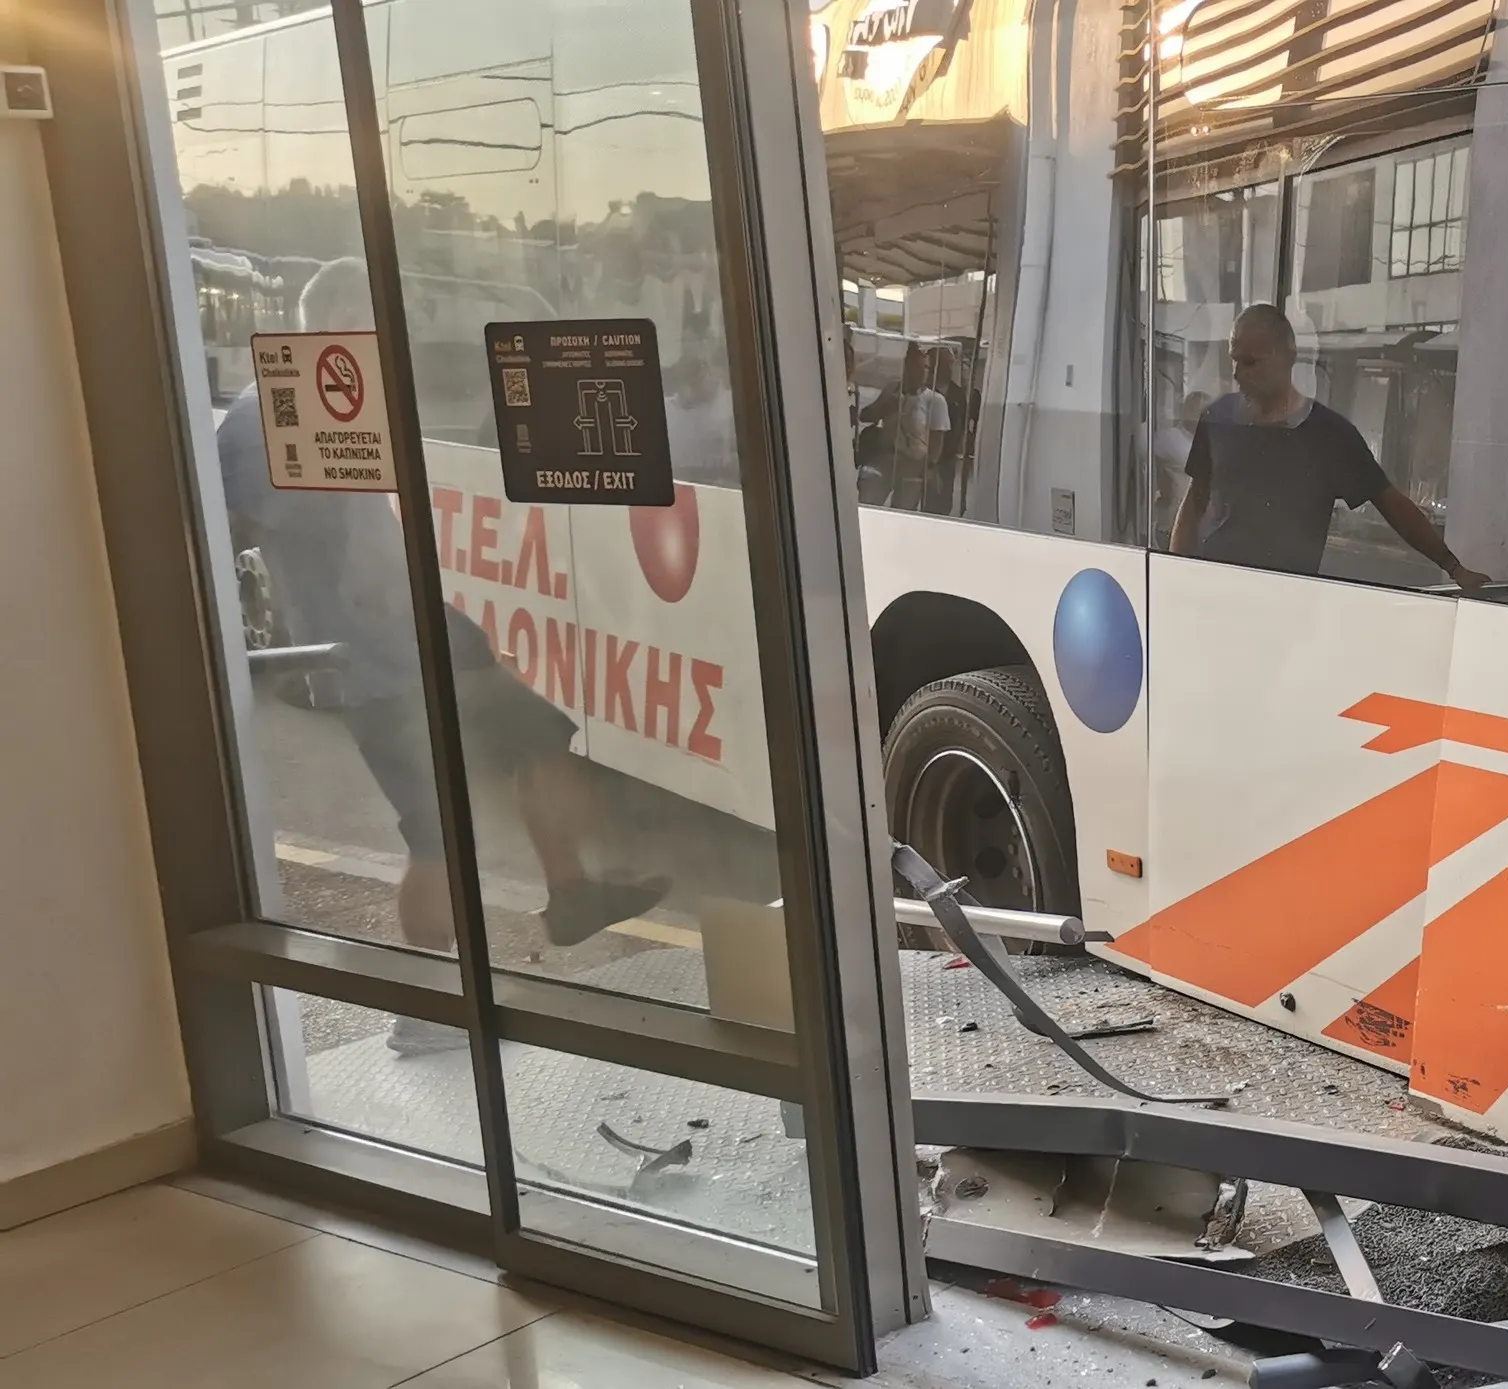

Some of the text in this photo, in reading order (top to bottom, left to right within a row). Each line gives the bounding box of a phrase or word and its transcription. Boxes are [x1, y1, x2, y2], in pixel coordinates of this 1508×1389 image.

[550, 335, 590, 347] ΠΡΟΣΟΧΗ
[602, 334, 641, 346] CAUTION
[259, 352, 278, 364] Ktel
[315, 431, 382, 444] ΑΠΑΓΟΡΕΥΕΤΑΙ
[319, 448, 382, 460] ΤΟ ΚΑΠΝΙΣΜΑ
[324, 467, 382, 480] NO SMOKING
[536, 471, 635, 490] ΕΞΟΔΟΣ / EXIT
[432, 487, 568, 600] Τ.Ε.Λ.
